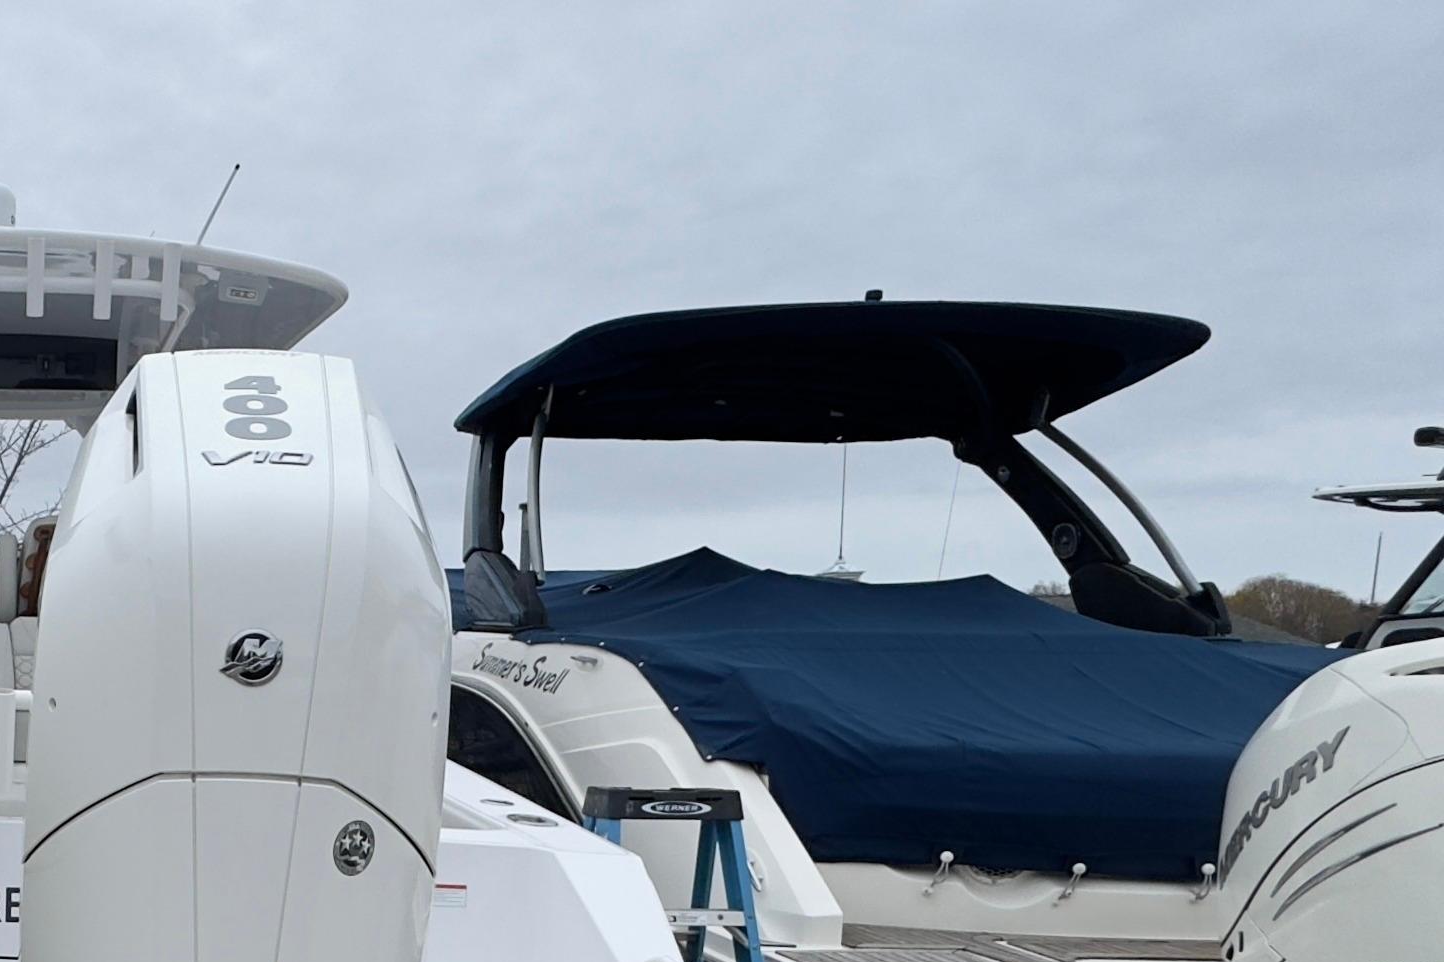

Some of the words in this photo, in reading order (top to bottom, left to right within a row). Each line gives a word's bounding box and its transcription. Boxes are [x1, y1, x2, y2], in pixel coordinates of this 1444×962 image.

[201, 450, 314, 466] V10
[523, 656, 571, 694] Swell
[655, 804, 699, 812] WERNER
[1220, 725, 1351, 890] MERCURY
